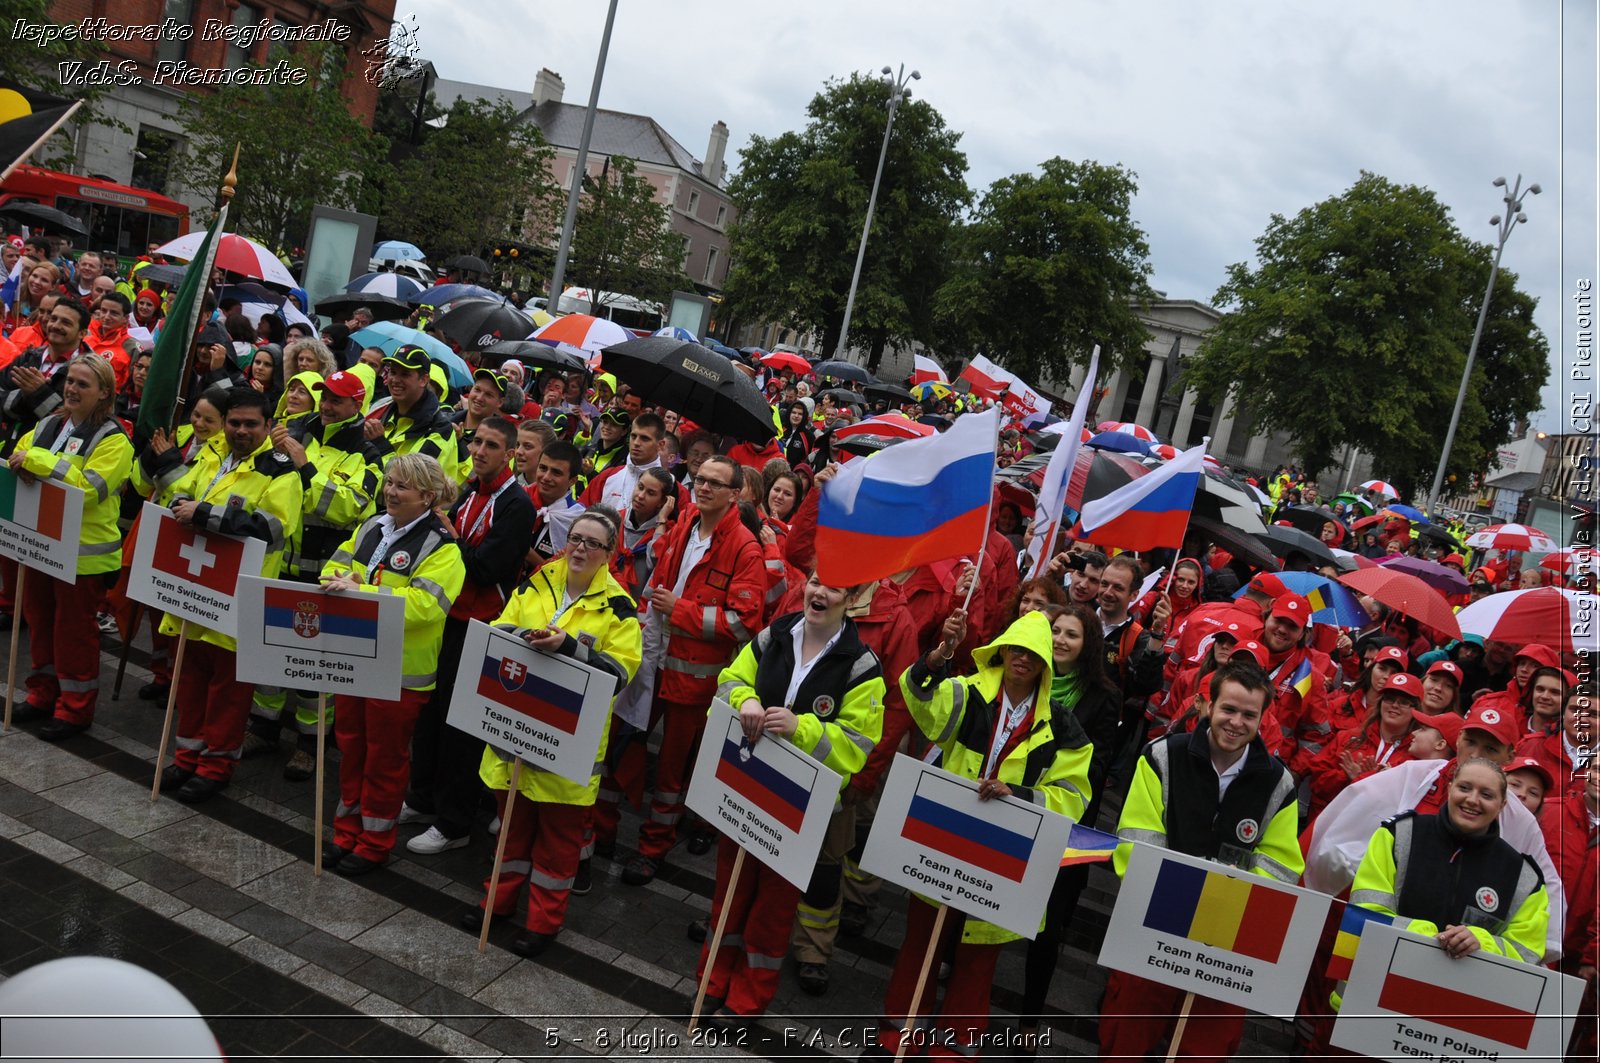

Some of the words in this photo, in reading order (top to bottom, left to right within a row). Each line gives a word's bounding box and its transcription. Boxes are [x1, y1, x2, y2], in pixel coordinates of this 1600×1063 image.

[0, 525, 19, 539] Team
[21, 533, 50, 552] Ireland
[17, 546, 27, 556] na
[29, 549, 64, 570] hÉireann
[151, 575, 175, 591] Team
[176, 585, 231, 612] Switzerland
[156, 591, 181, 608] Team
[182, 601, 220, 622] Schweiz
[284, 668, 323, 681] Србија
[285, 655, 316, 667] Team
[318, 660, 354, 672] Serbia
[481, 720, 500, 736] Tím
[502, 731, 557, 761] Slovensko
[484, 706, 513, 726] Team
[514, 720, 560, 747] Slovakia
[717, 806, 740, 828] Team
[741, 823, 780, 857] Slovenija
[723, 793, 745, 815] Team
[746, 811, 783, 842] Slovenia
[902, 865, 954, 892] Сборная
[956, 886, 1001, 911] России
[919, 854, 951, 874] Team
[953, 868, 994, 891] Russia
[1147, 955, 1191, 975] Echipa
[1194, 968, 1253, 993] România
[1156, 940, 1192, 960] Team
[1195, 952, 1255, 977] Romania
[1393, 1040, 1435, 1062] Team
[1396, 1023, 1438, 1044] Team
[1443, 1037, 1499, 1062] Poland
